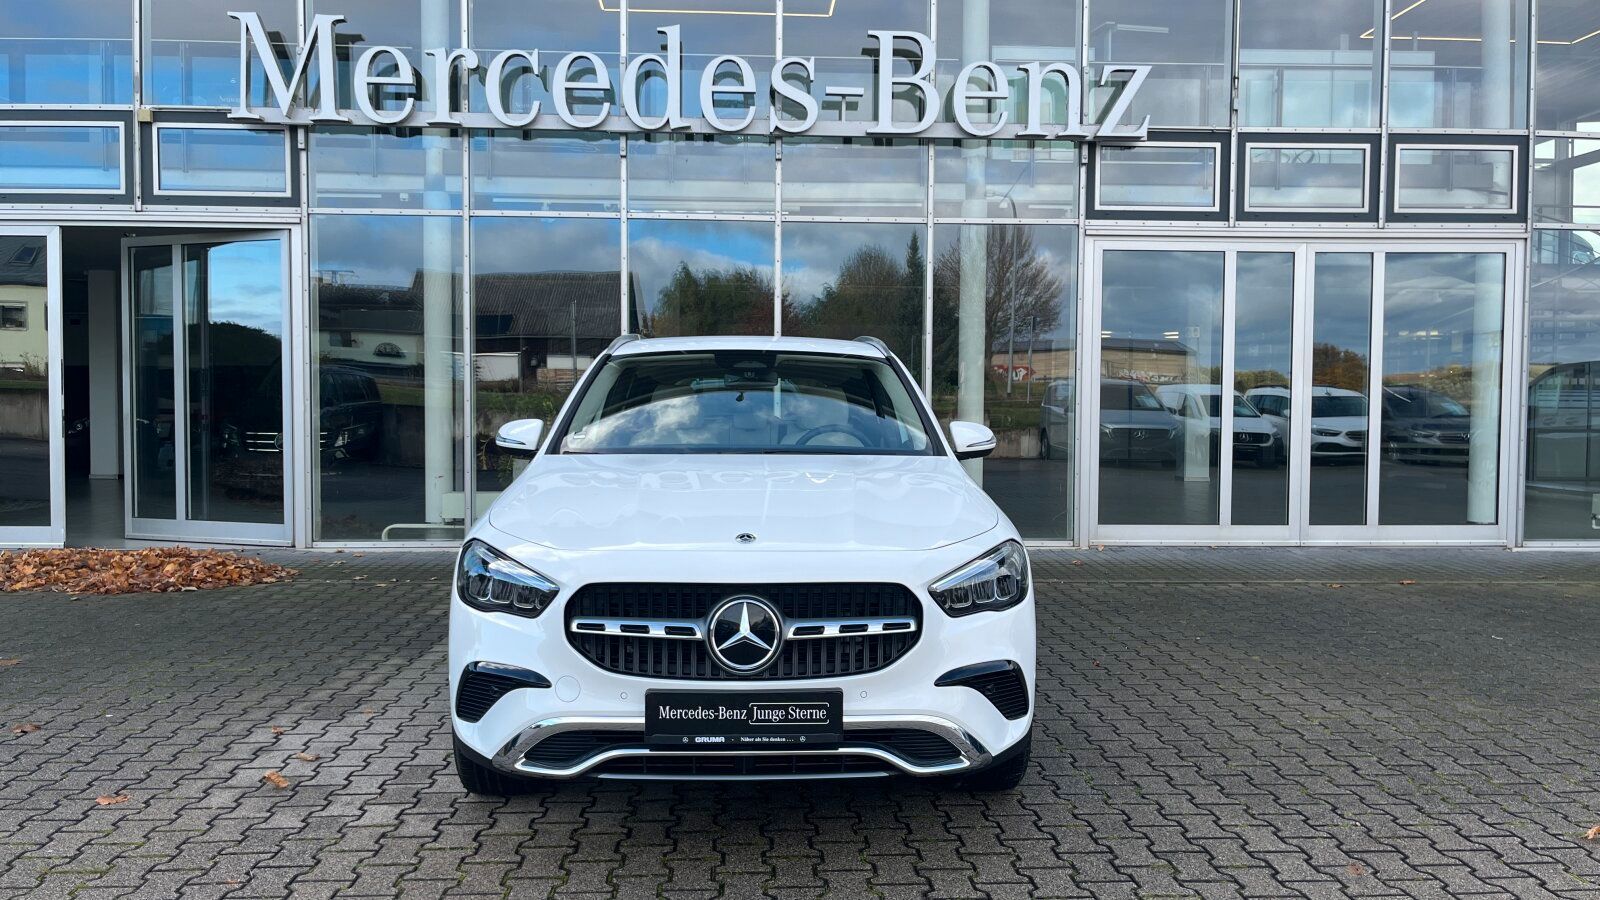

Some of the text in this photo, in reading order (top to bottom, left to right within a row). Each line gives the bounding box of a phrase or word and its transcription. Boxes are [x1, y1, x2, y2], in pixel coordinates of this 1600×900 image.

[227, 11, 1151, 140] Mercedes-Benz
[658, 705, 827, 722] Mercedes-Benz Junge Sterne
